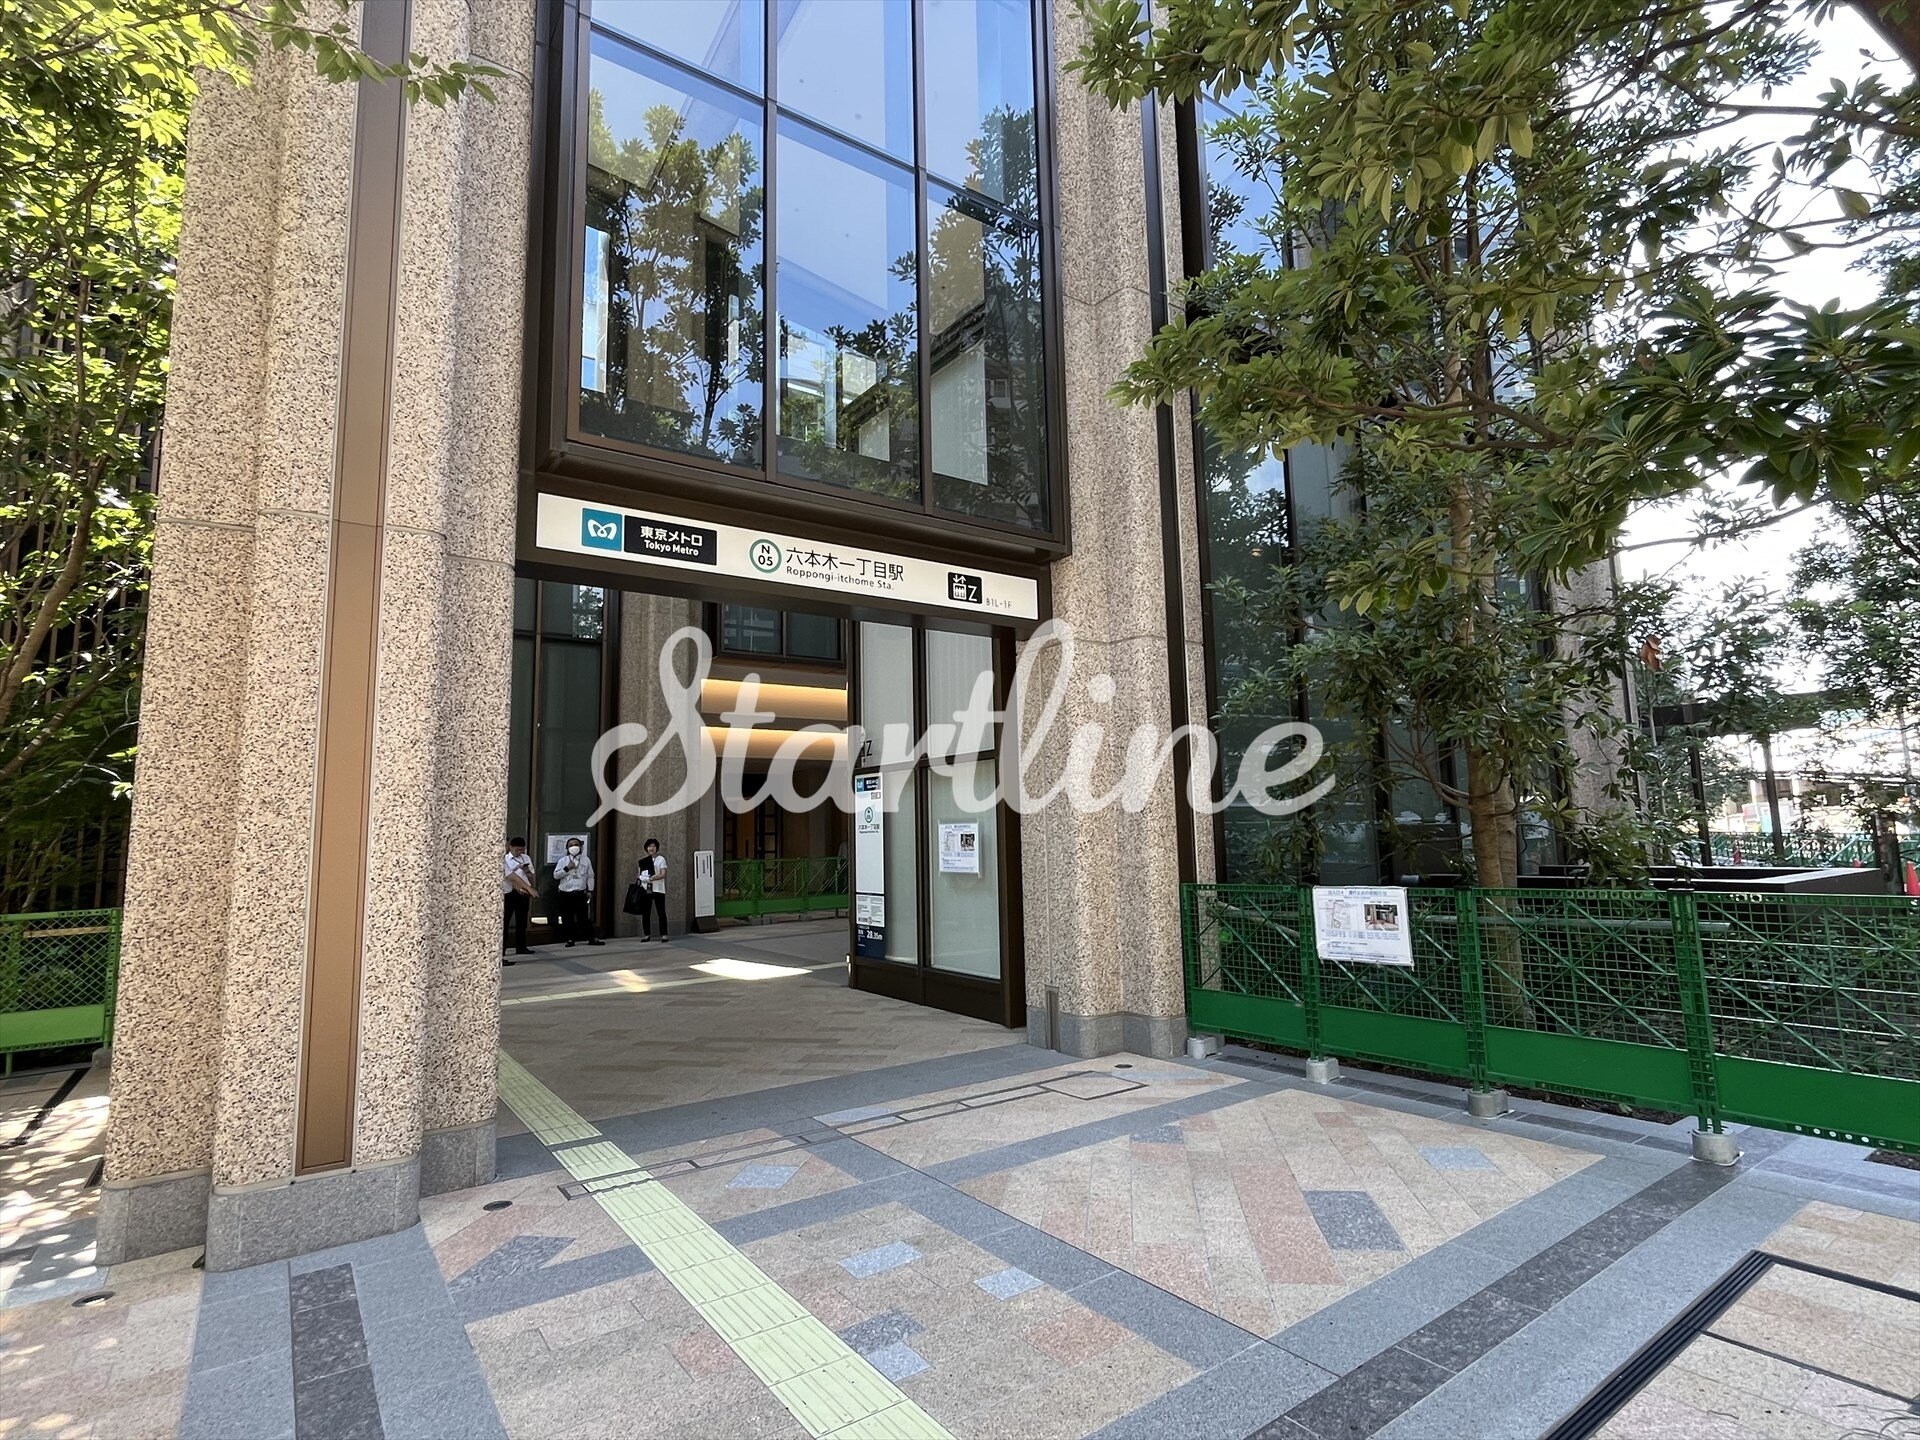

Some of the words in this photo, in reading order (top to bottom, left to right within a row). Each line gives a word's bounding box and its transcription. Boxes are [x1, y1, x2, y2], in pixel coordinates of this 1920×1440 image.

[640, 525, 703, 547] 東京メトロ
[644, 539, 671, 553] Tokyo
[672, 543, 699, 556] Metro
[761, 545, 770, 554] N
[758, 555, 773, 566] 05
[786, 547, 904, 581] 六本木一丁目駅
[786, 566, 875, 588] Roppongi-itchome
[877, 580, 895, 591] Sta.
[968, 585, 978, 602] Z
